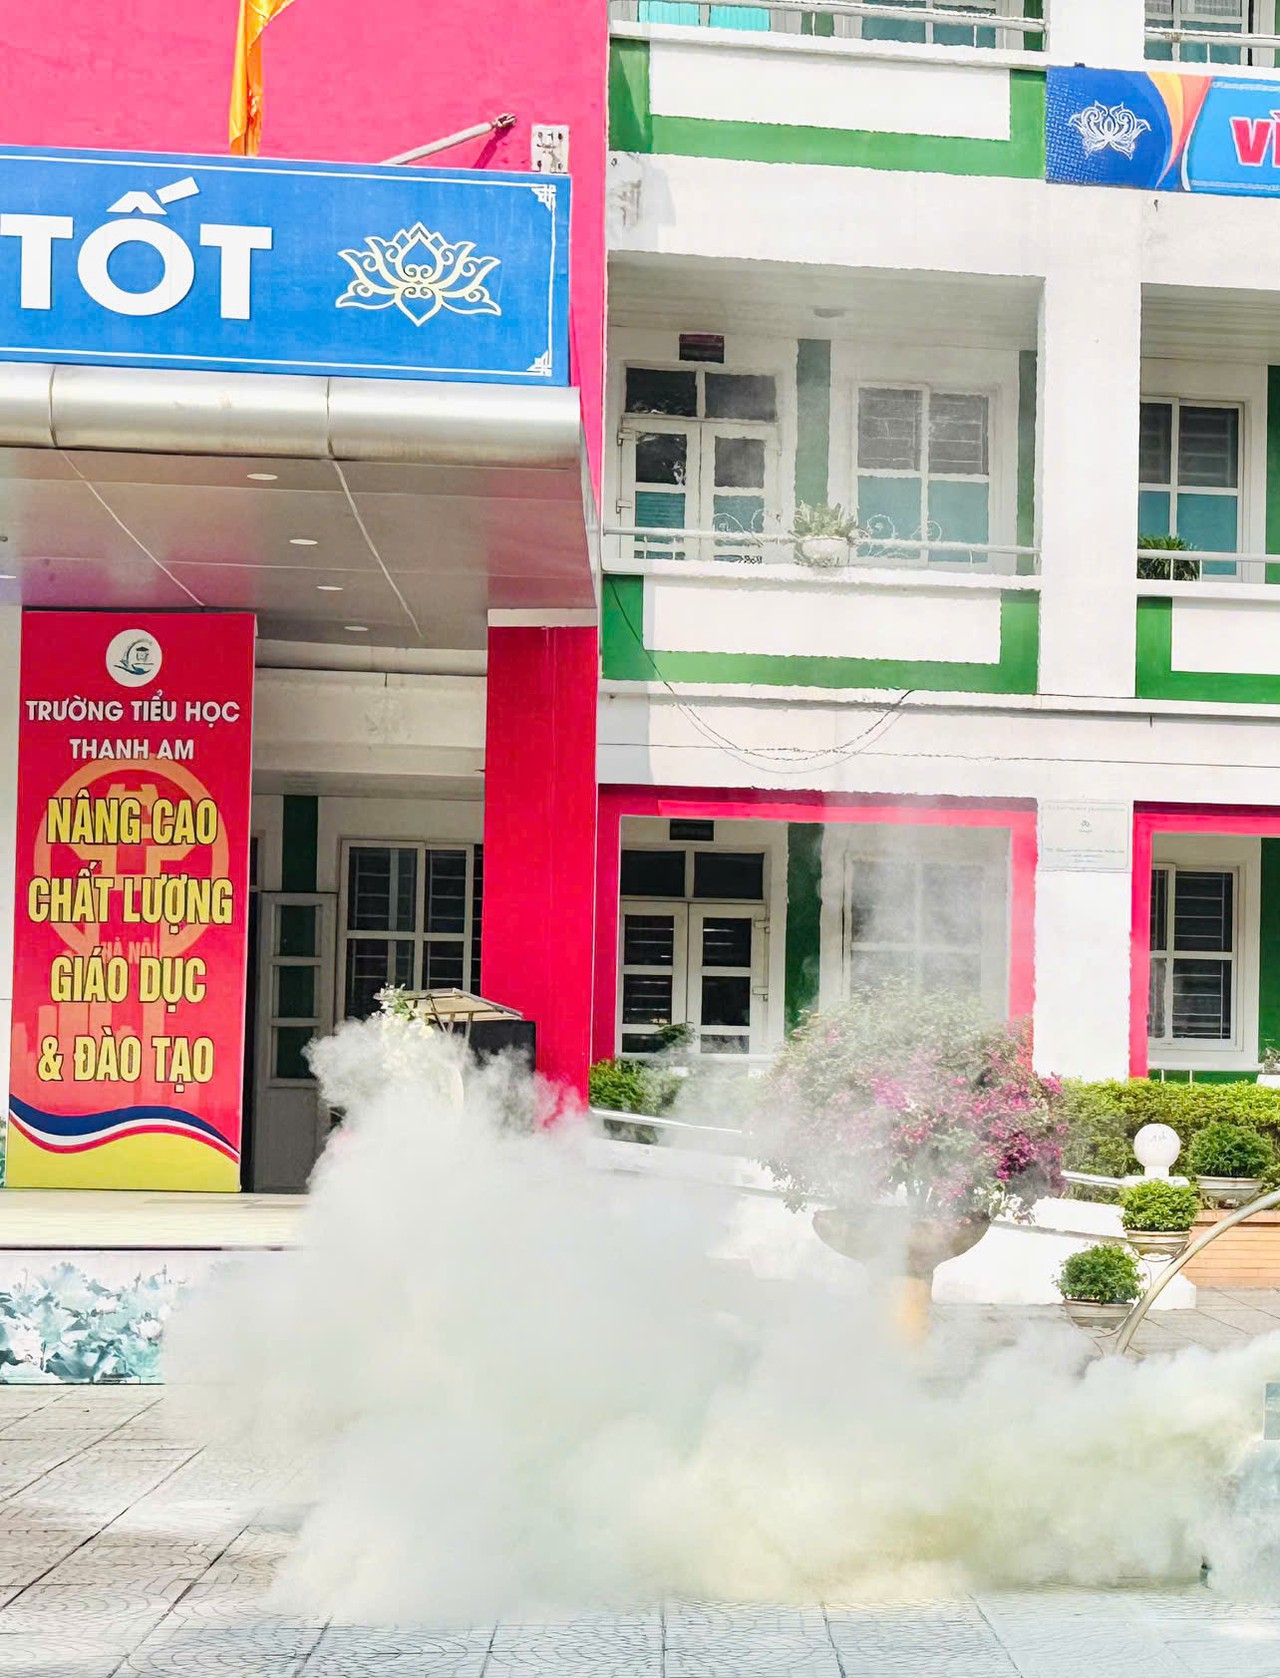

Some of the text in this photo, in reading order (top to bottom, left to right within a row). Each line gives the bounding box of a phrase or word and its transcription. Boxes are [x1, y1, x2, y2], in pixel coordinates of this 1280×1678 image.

[0, 176, 273, 320] TỐT
[25, 689, 240, 728] TRƯỜNG TIỂU HỌC
[69, 738, 194, 760] THANH AM
[46, 788, 218, 845] NÂNG CAO
[28, 860, 234, 934] CHẤT LƯỢNG
[51, 946, 207, 1013] GIÁO DỤC
[37, 1025, 214, 1093] & ĐÀO TẠO
